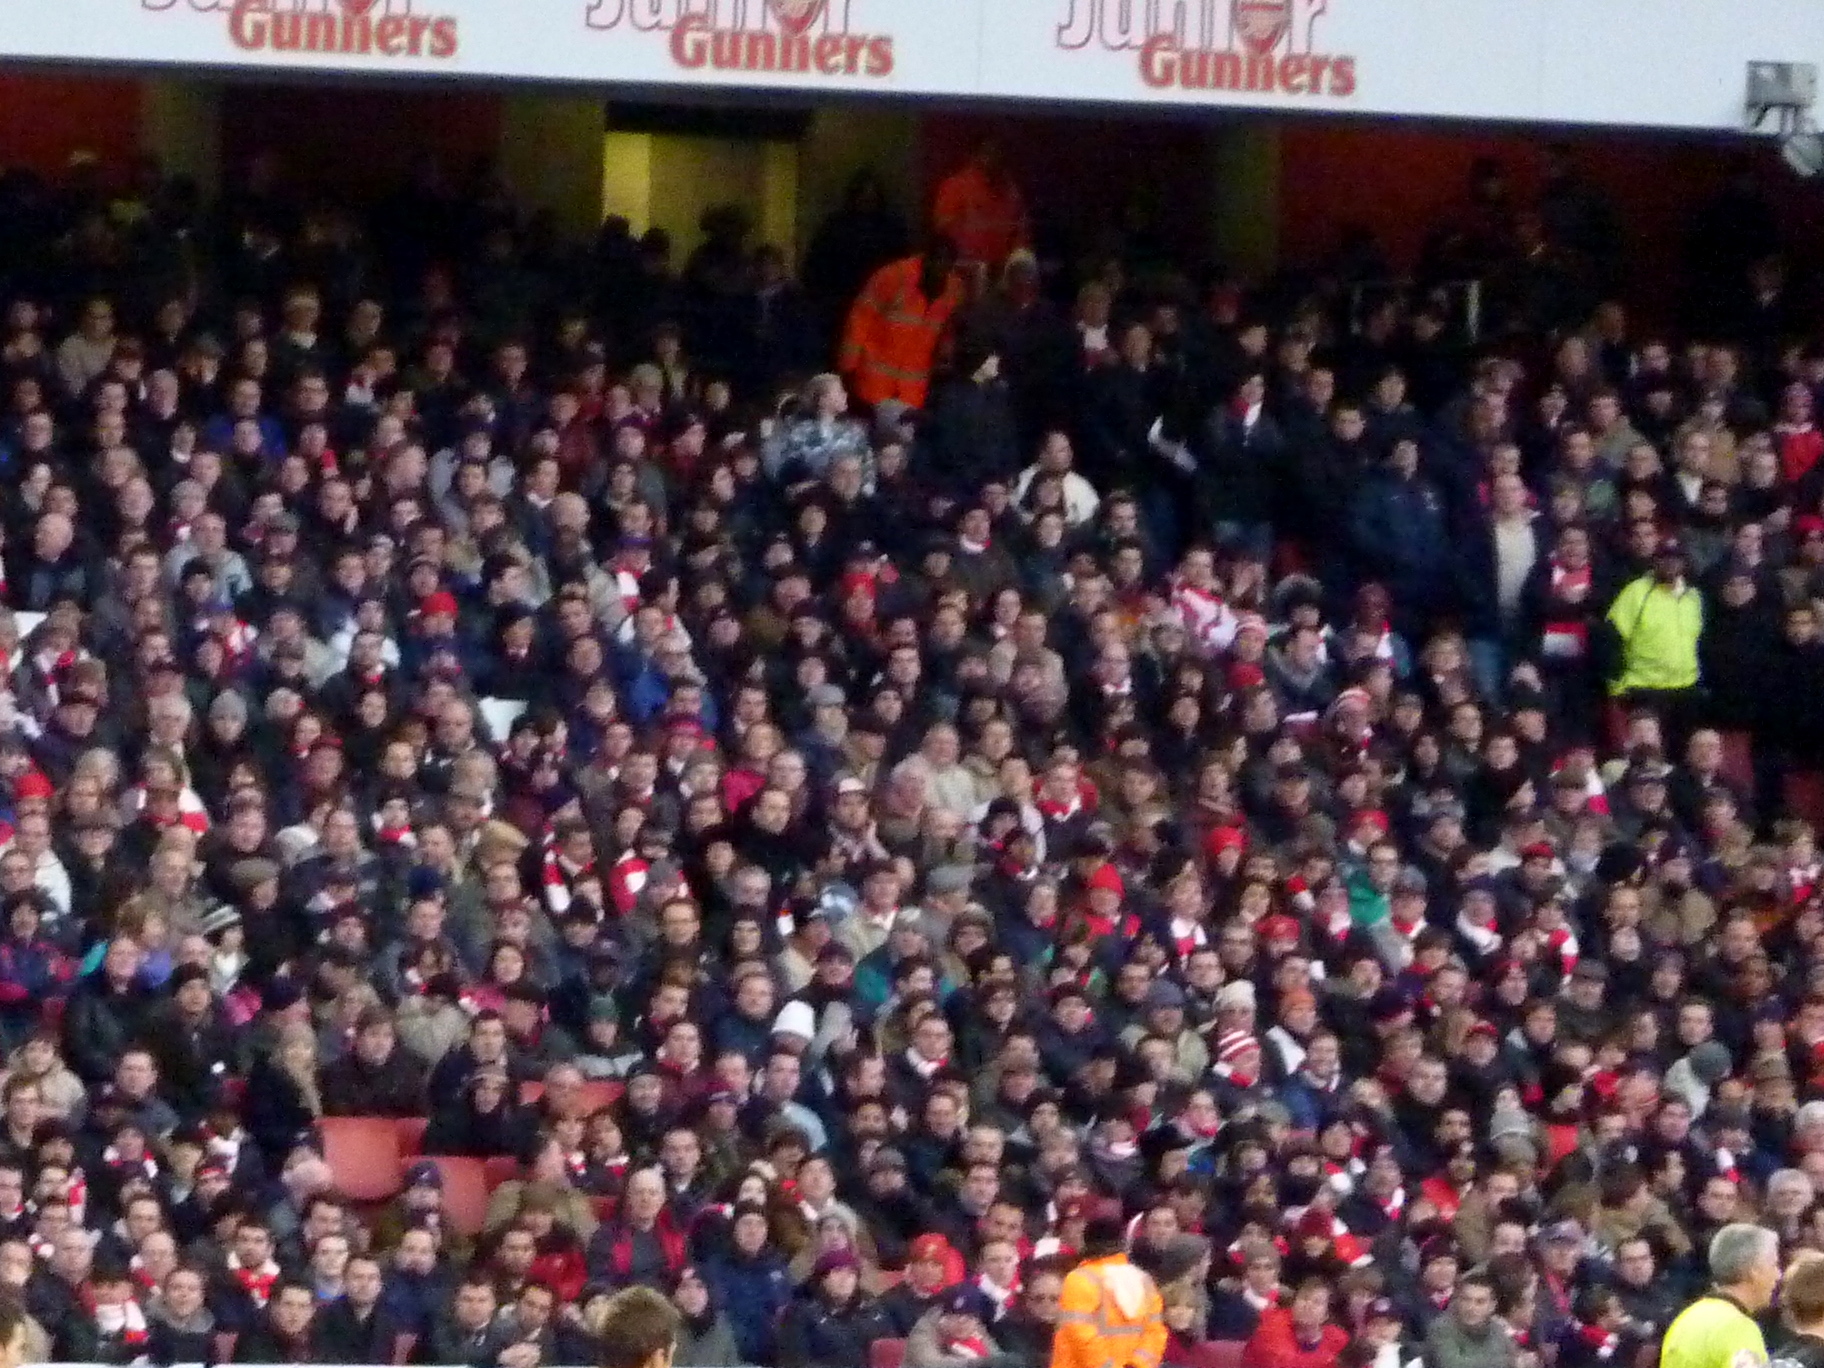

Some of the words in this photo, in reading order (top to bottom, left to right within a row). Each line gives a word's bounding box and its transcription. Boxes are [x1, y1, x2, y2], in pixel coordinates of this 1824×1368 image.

[229, 0, 459, 57] Gunners
[670, 12, 895, 76] Gunners
[1139, 32, 1357, 95] Gunners
